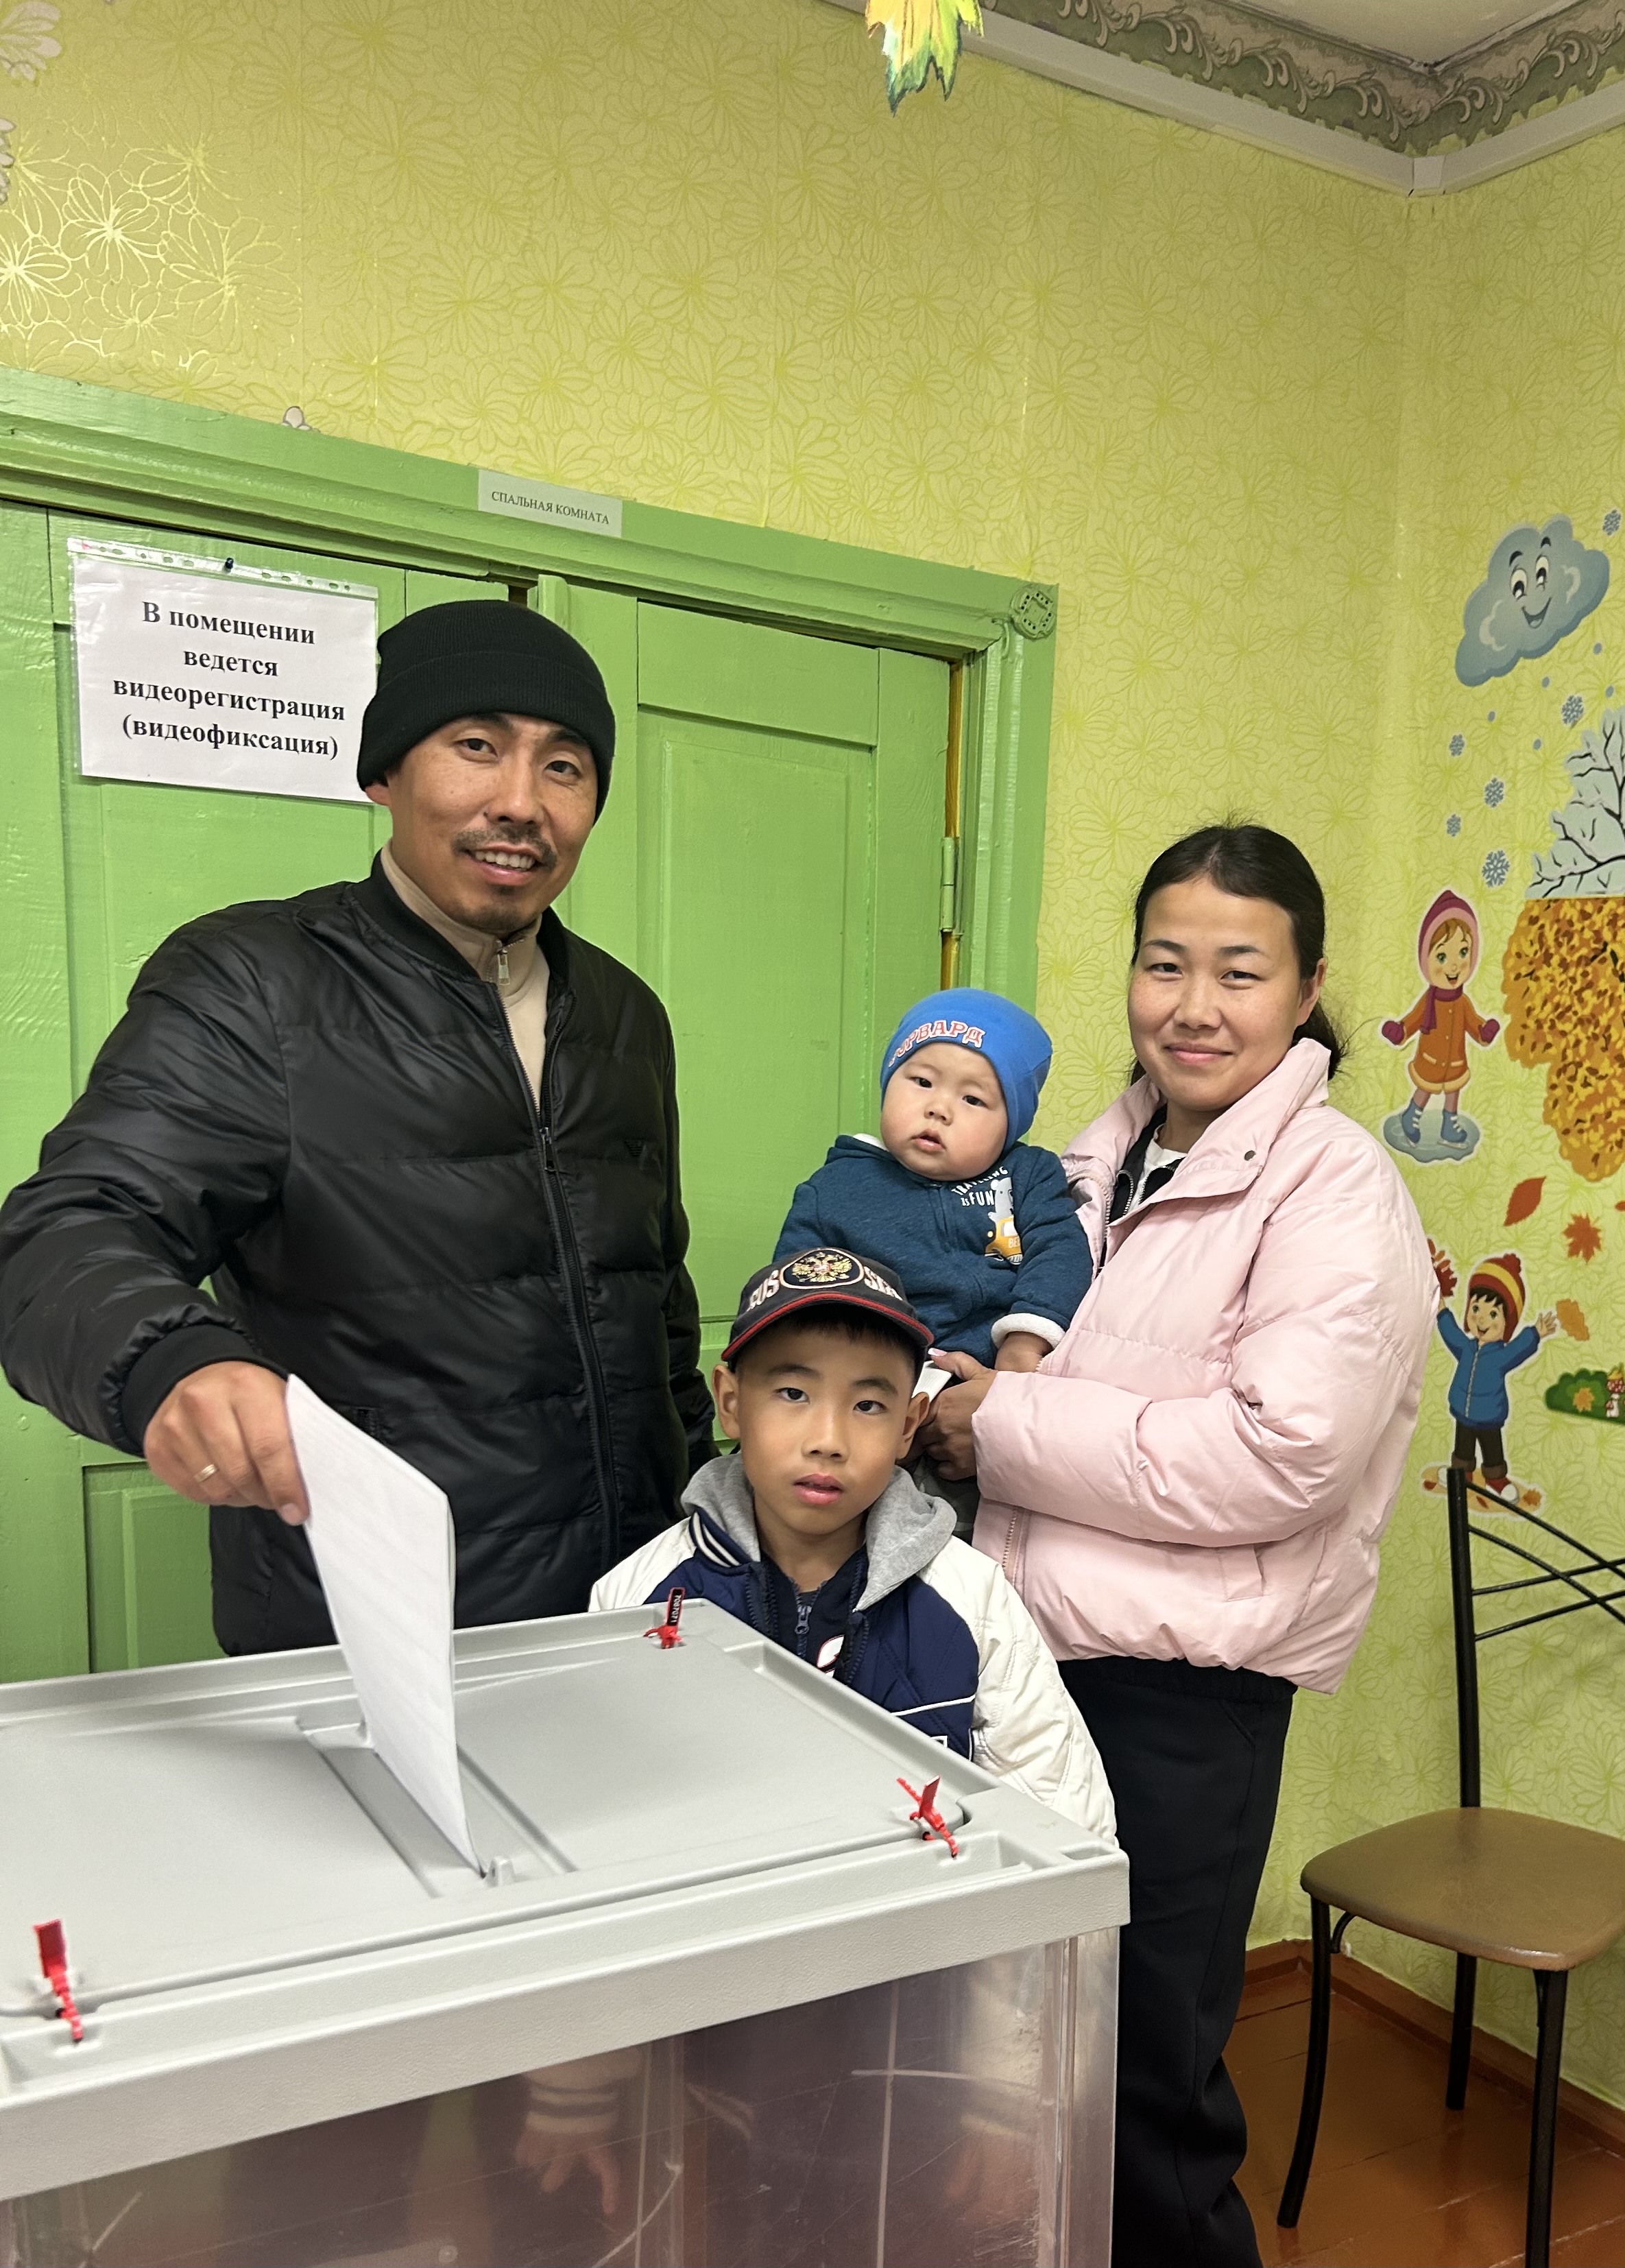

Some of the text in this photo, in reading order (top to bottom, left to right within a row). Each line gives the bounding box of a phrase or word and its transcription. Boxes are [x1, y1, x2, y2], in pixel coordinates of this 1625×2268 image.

[491, 491, 610, 525] СПАЛЬНАЯ КОМНАТА
[142, 601, 315, 645] В помещении
[183, 650, 278, 676] ведется
[112, 679, 345, 720] видеорегистрация
[122, 714, 338, 760] (видеофиксация)
[969, 1190, 994, 1206] FUN
